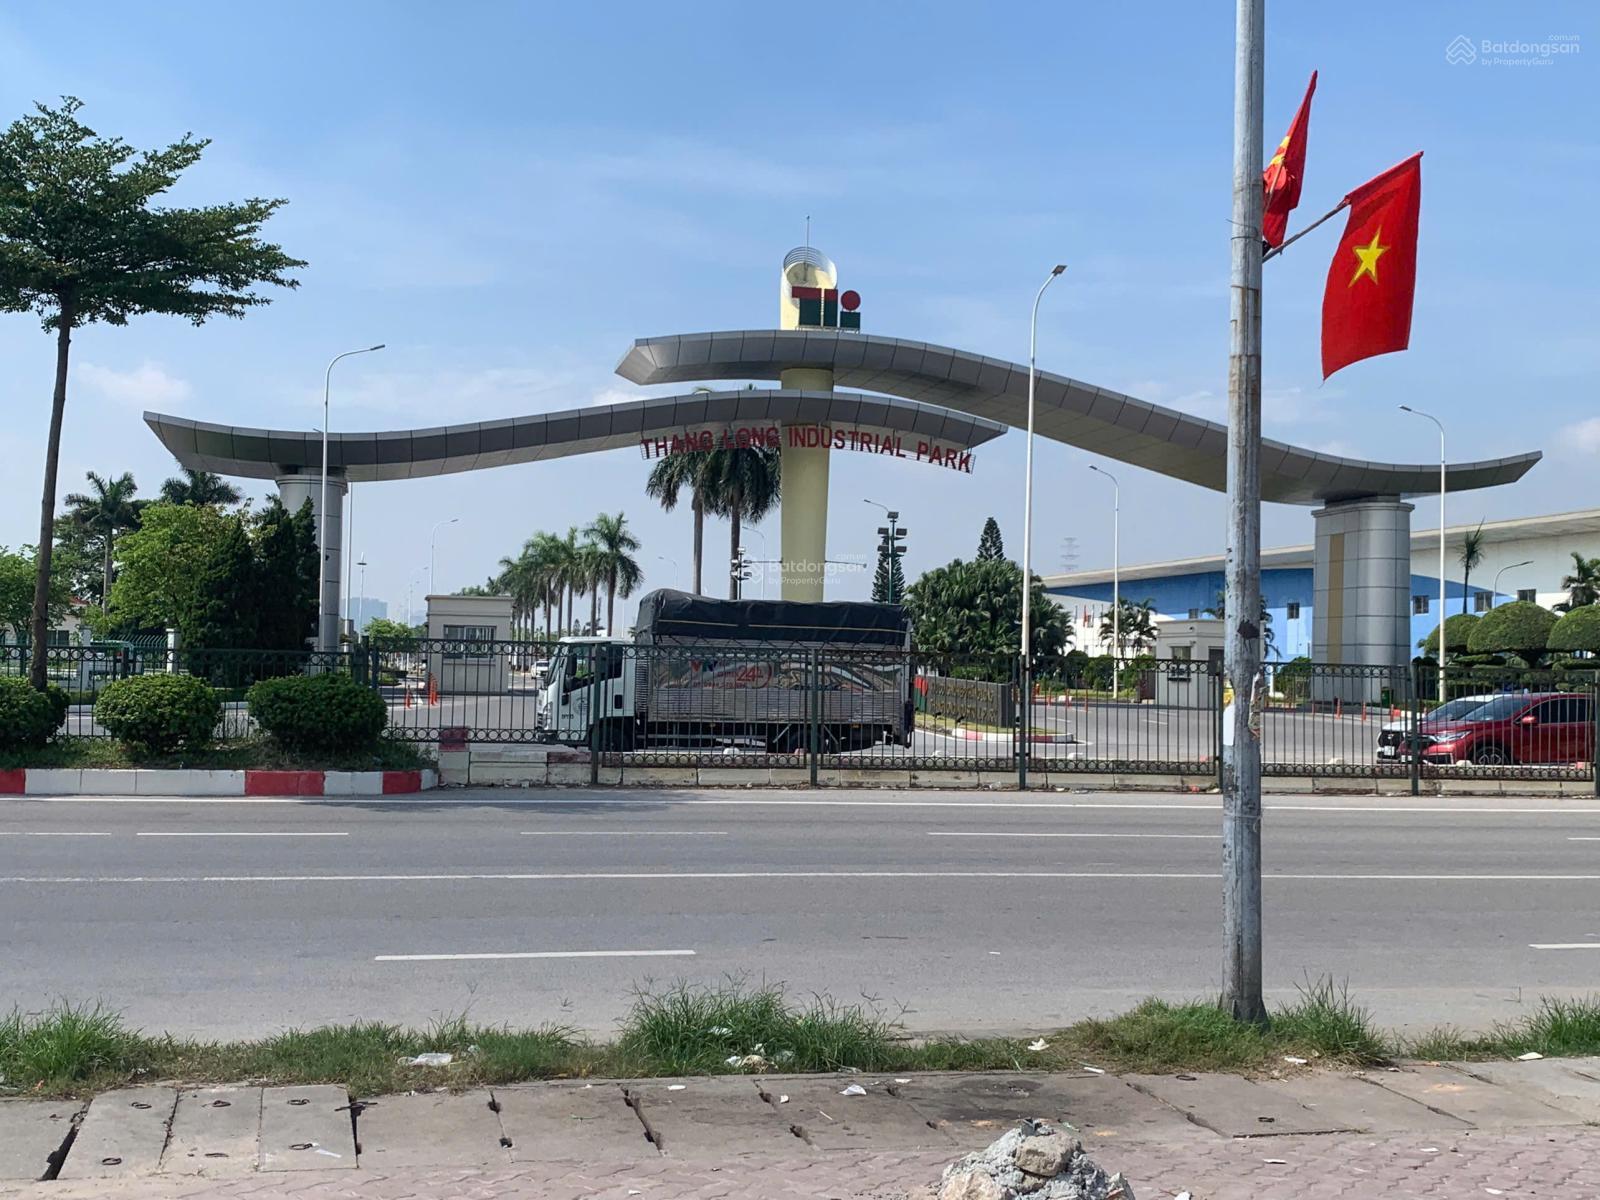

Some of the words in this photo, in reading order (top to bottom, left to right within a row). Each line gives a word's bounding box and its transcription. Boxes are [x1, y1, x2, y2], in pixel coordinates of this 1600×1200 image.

[641, 429, 714, 459] THANG
[721, 427, 781, 450] LONG
[788, 427, 906, 458] INDUSTRIAL
[916, 440, 971, 473] PARK
